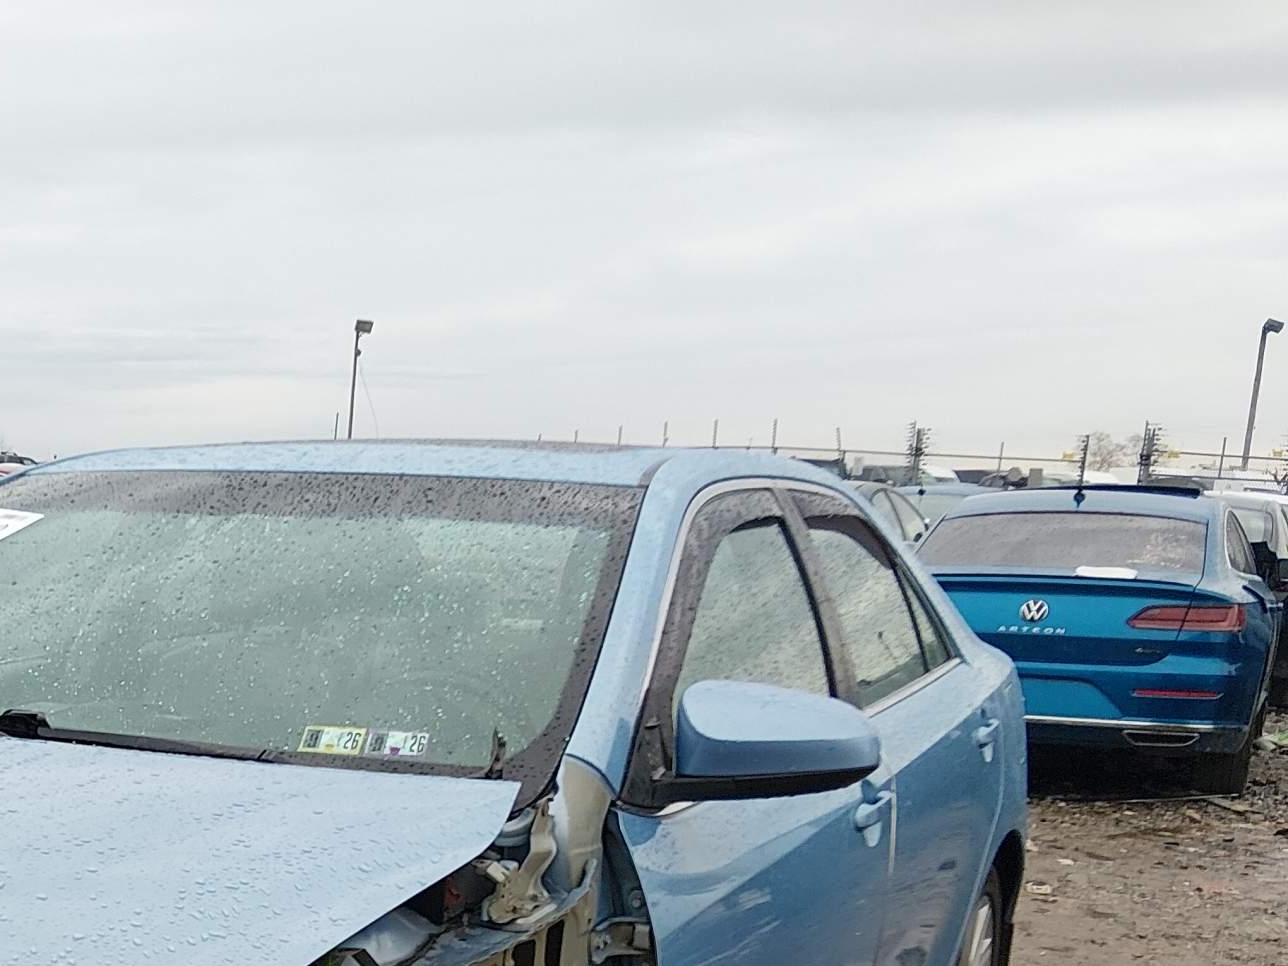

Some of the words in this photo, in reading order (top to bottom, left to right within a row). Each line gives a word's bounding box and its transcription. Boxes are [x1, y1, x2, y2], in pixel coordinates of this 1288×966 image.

[997, 625, 1066, 635] ARTEON
[343, 731, 362, 750] 26
[409, 735, 426, 753] 26
